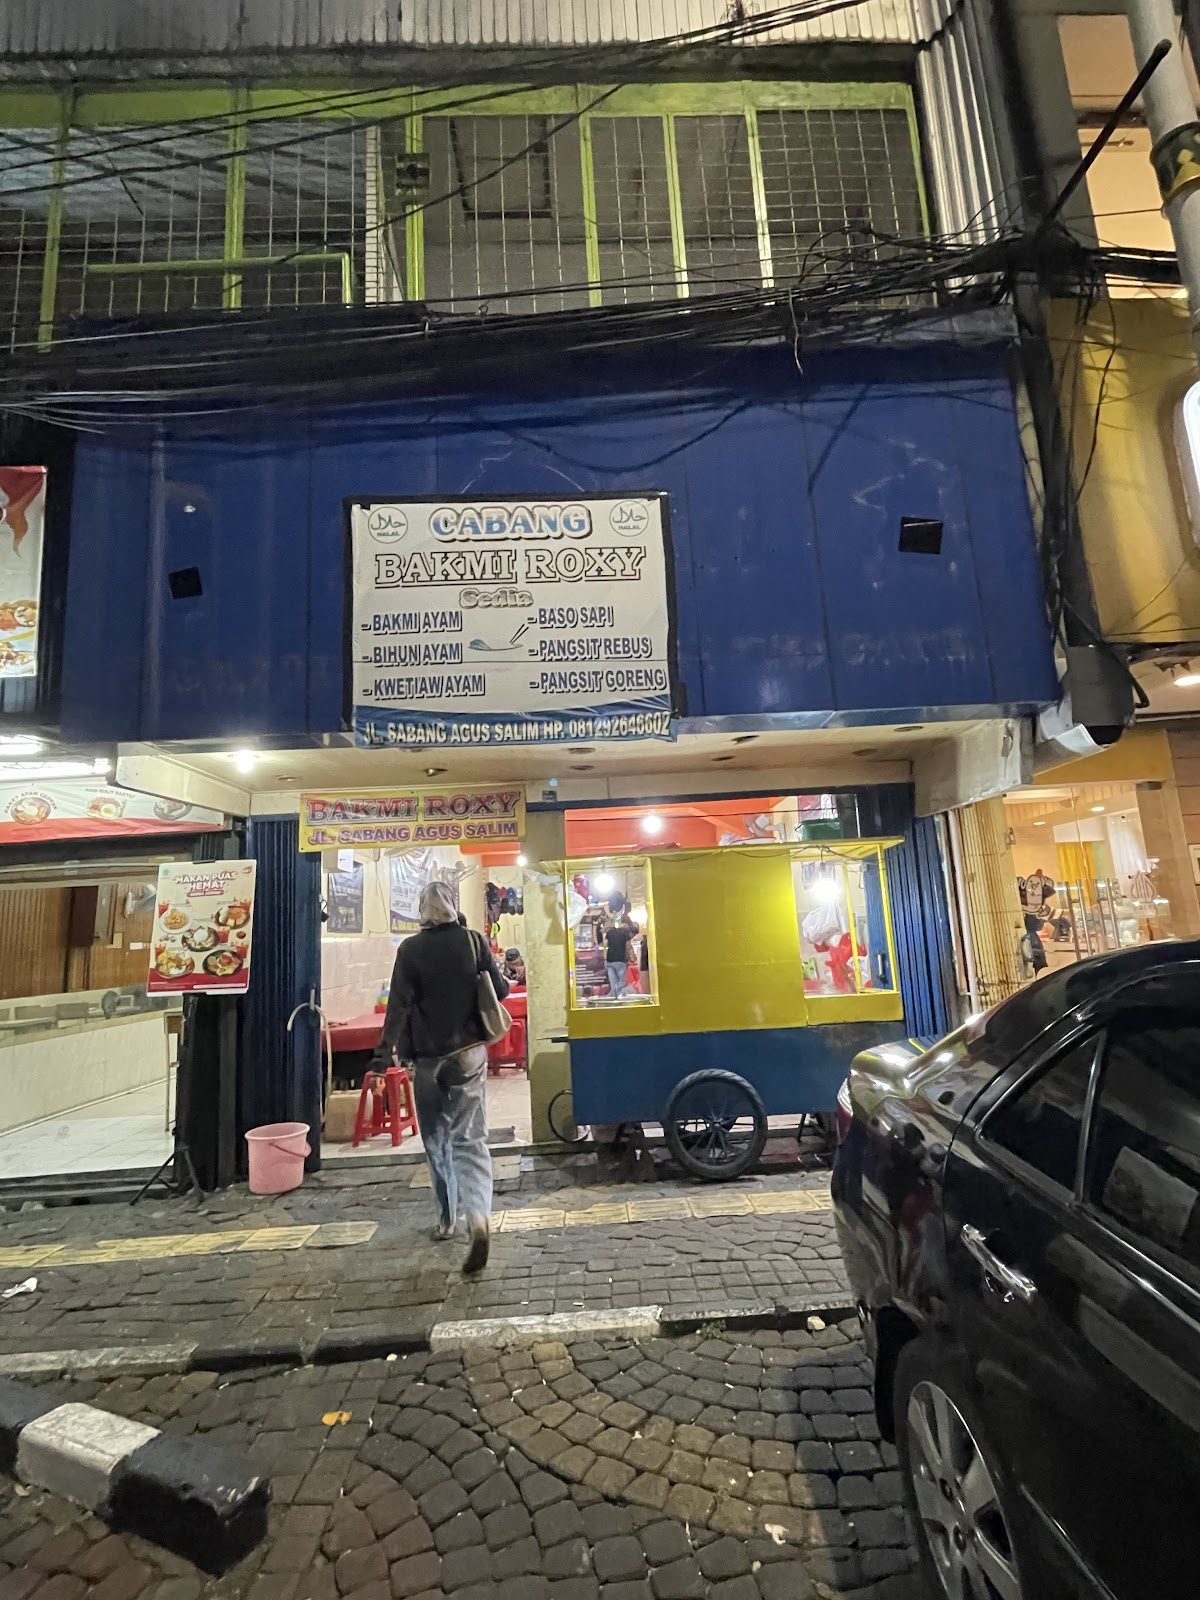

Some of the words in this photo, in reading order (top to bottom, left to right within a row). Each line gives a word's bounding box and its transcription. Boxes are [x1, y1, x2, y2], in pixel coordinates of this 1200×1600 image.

[429, 504, 592, 542] CABANG
[375, 549, 517, 588] BAKMI
[525, 546, 646, 583] ROXY
[459, 587, 534, 609] Sedia
[422, 610, 462, 633] AYAM
[580, 606, 615, 627] SAPI
[423, 642, 463, 665] AYAM
[603, 637, 652, 659] REBUS
[445, 673, 485, 697] AYAM
[605, 668, 667, 691] GORENG
[363, 721, 384, 745] JL.
[387, 721, 447, 744] SABANG
[450, 722, 491, 743] AGUS
[494, 721, 539, 742] SALIM
[543, 719, 565, 740] HP.
[306, 795, 419, 826] BAKMI
[423, 791, 521, 821] ROXY
[338, 826, 410, 845] SABANG
[411, 822, 462, 842] AGUS
[463, 821, 519, 838] SALIM
[175, 873, 209, 884] MAKAN
[211, 870, 238, 881] PUAS
[189, 879, 225, 891] HEMAT
